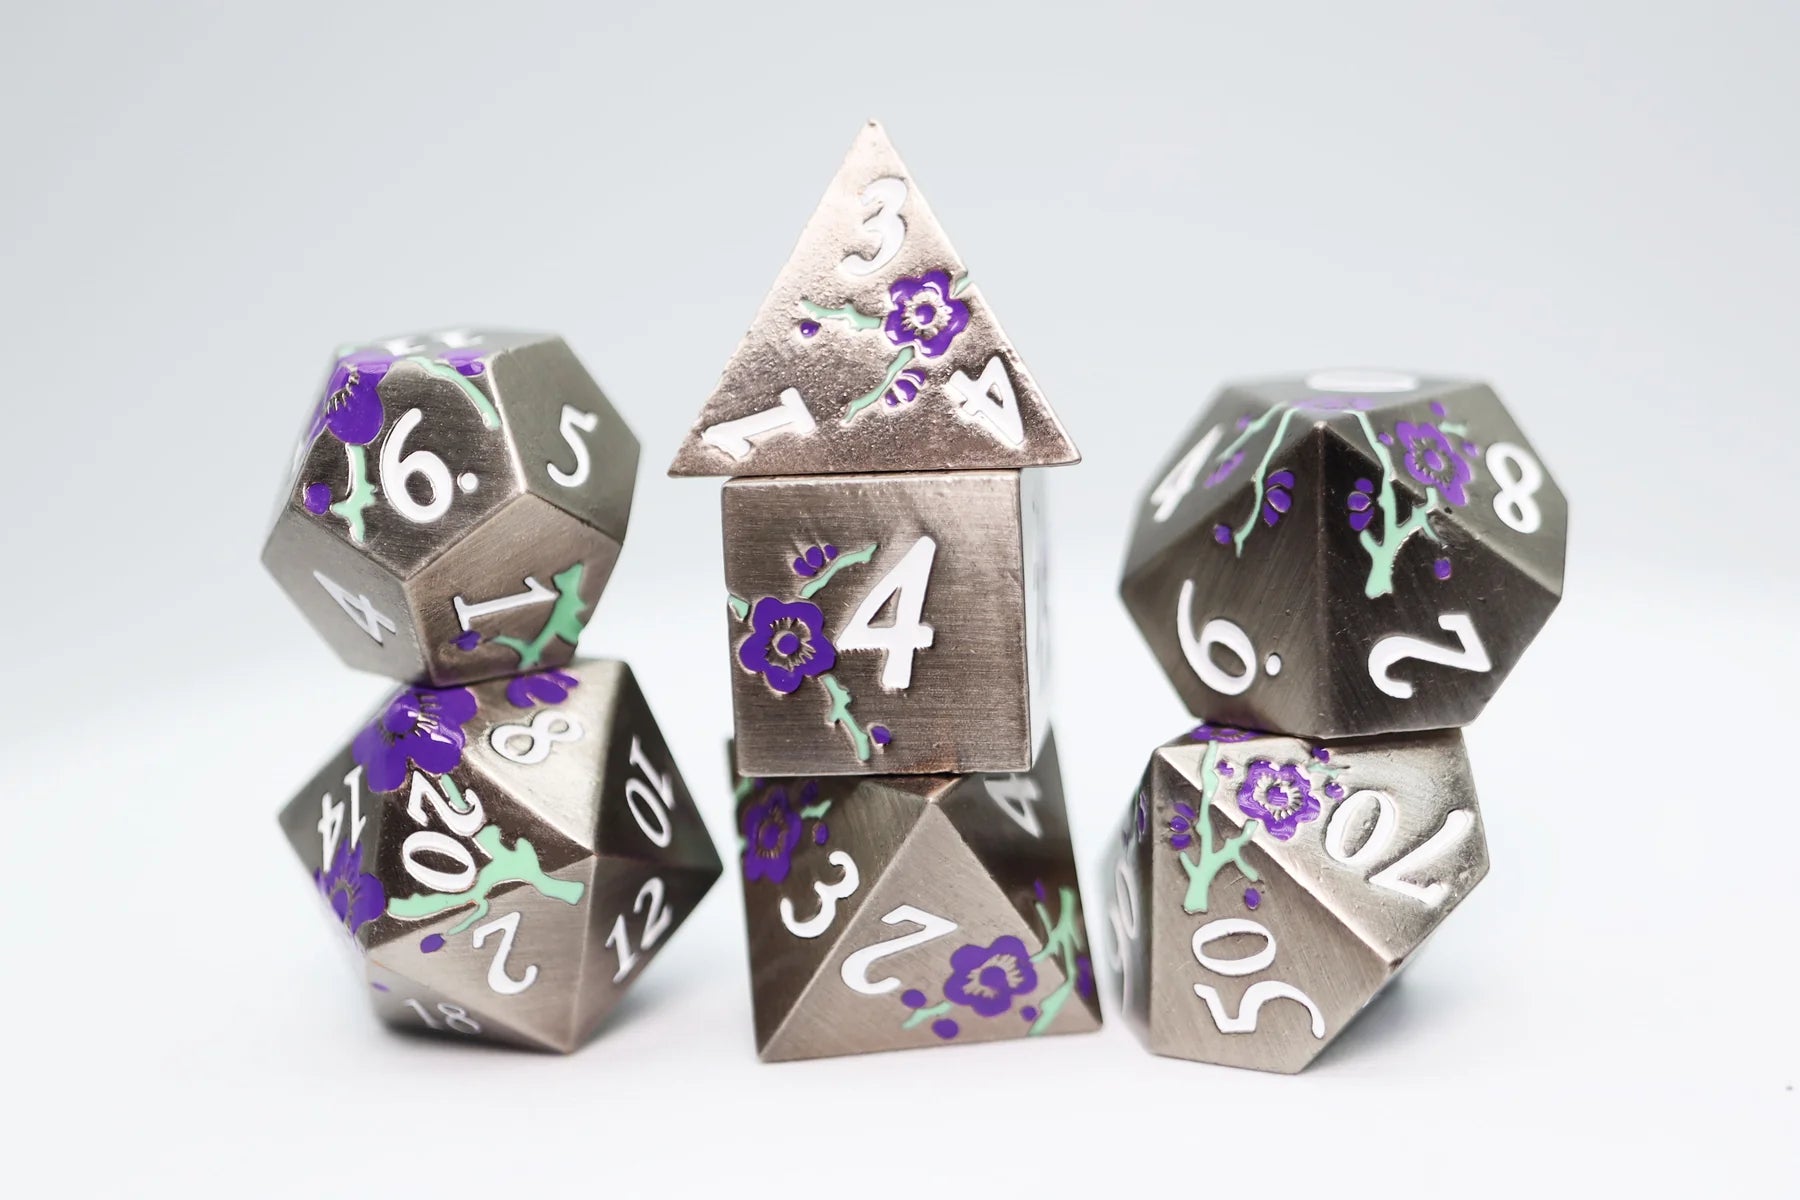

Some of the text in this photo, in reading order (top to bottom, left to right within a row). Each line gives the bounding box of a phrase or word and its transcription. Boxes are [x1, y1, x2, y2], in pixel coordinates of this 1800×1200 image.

[838, 175, 908, 276] 3
[701, 386, 818, 461] 1
[948, 355, 1025, 446] 4
[1485, 441, 1543, 534] 8
[313, 570, 396, 647] 4
[453, 576, 559, 631] 1
[835, 536, 934, 690] 4
[490, 710, 584, 764] 8
[318, 764, 366, 873] 14
[402, 770, 488, 892] 20
[624, 736, 677, 848] 10
[983, 773, 1041, 839] 4
[1325, 790, 1475, 907] 70
[605, 876, 673, 983] 12
[779, 850, 860, 939] 3
[471, 911, 539, 995] 2
[840, 904, 959, 995] 2
[1191, 917, 1326, 1039] 50
[405, 998, 481, 1034] 18
